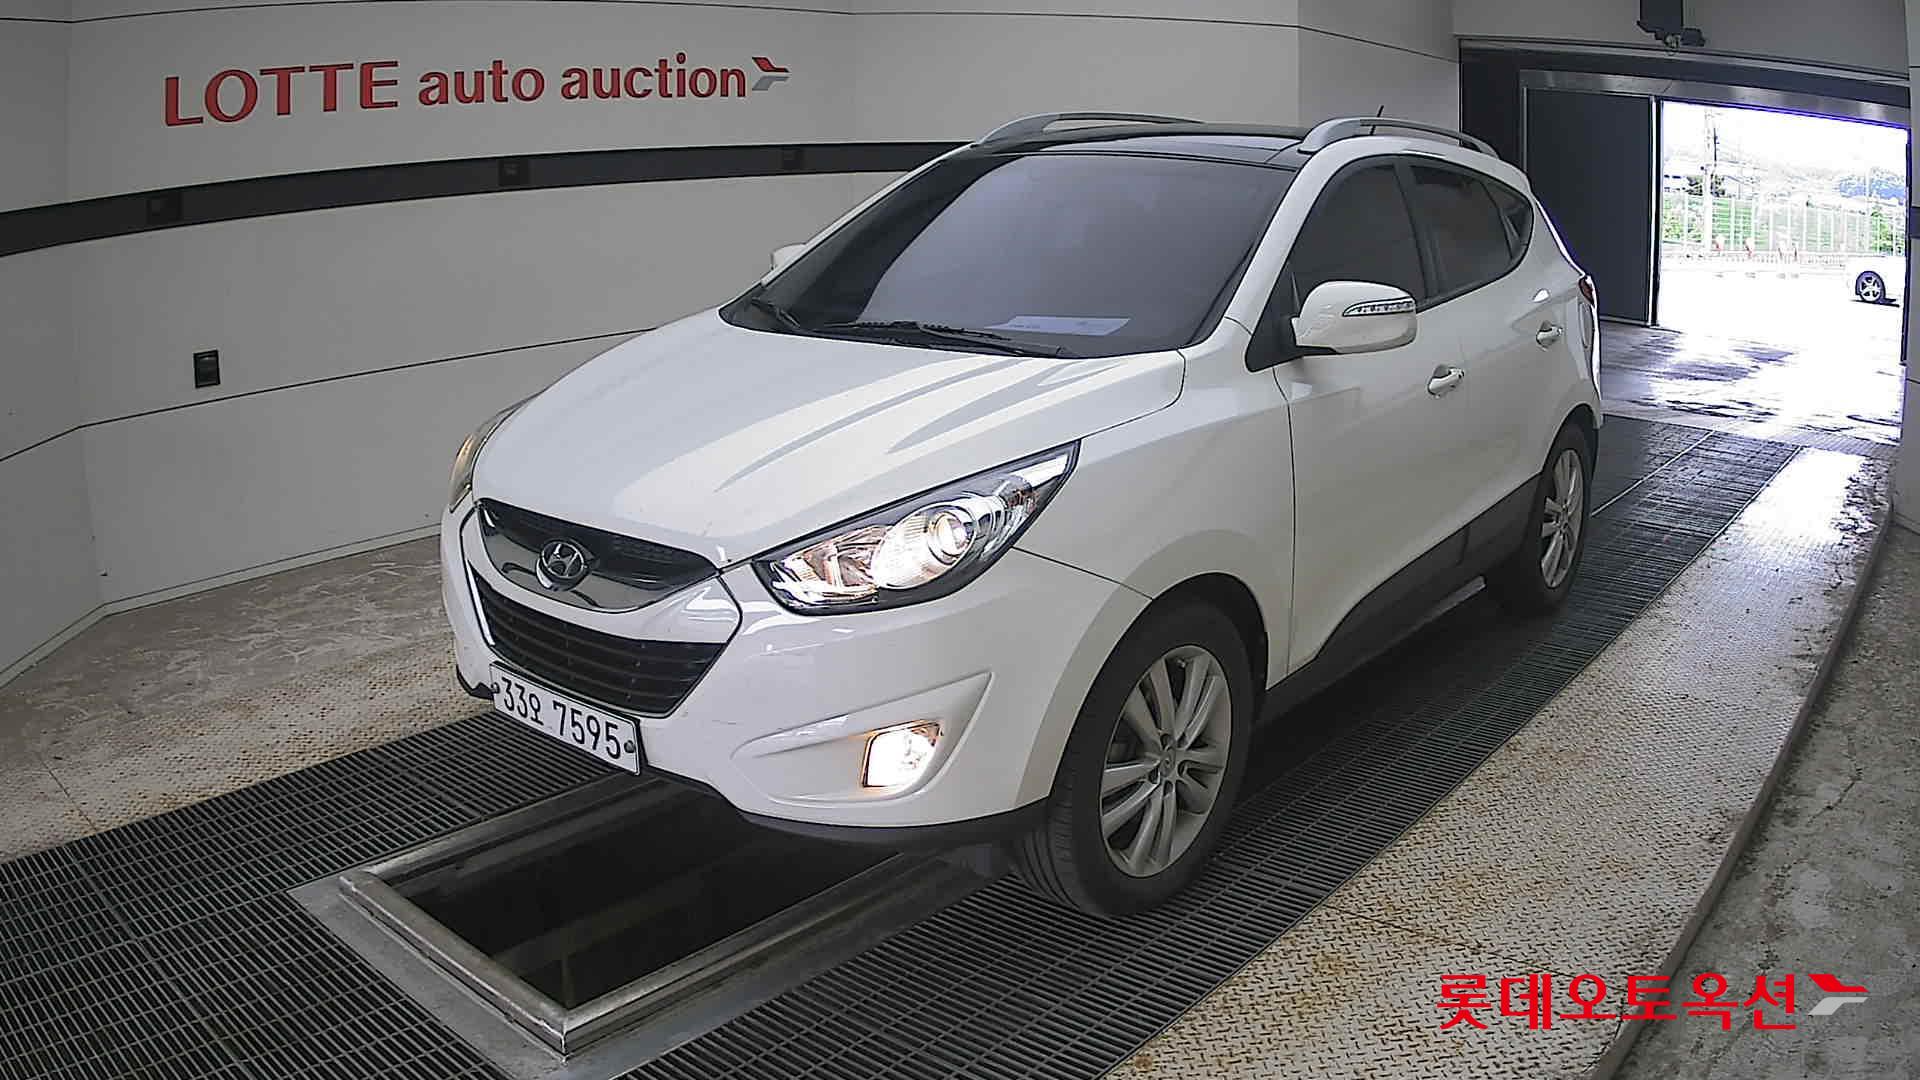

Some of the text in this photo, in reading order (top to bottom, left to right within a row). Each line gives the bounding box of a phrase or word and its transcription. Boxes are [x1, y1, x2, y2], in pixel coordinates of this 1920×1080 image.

[164, 52, 747, 126] LOTTE auto auction
[501, 676, 621, 759] 33오 7595
